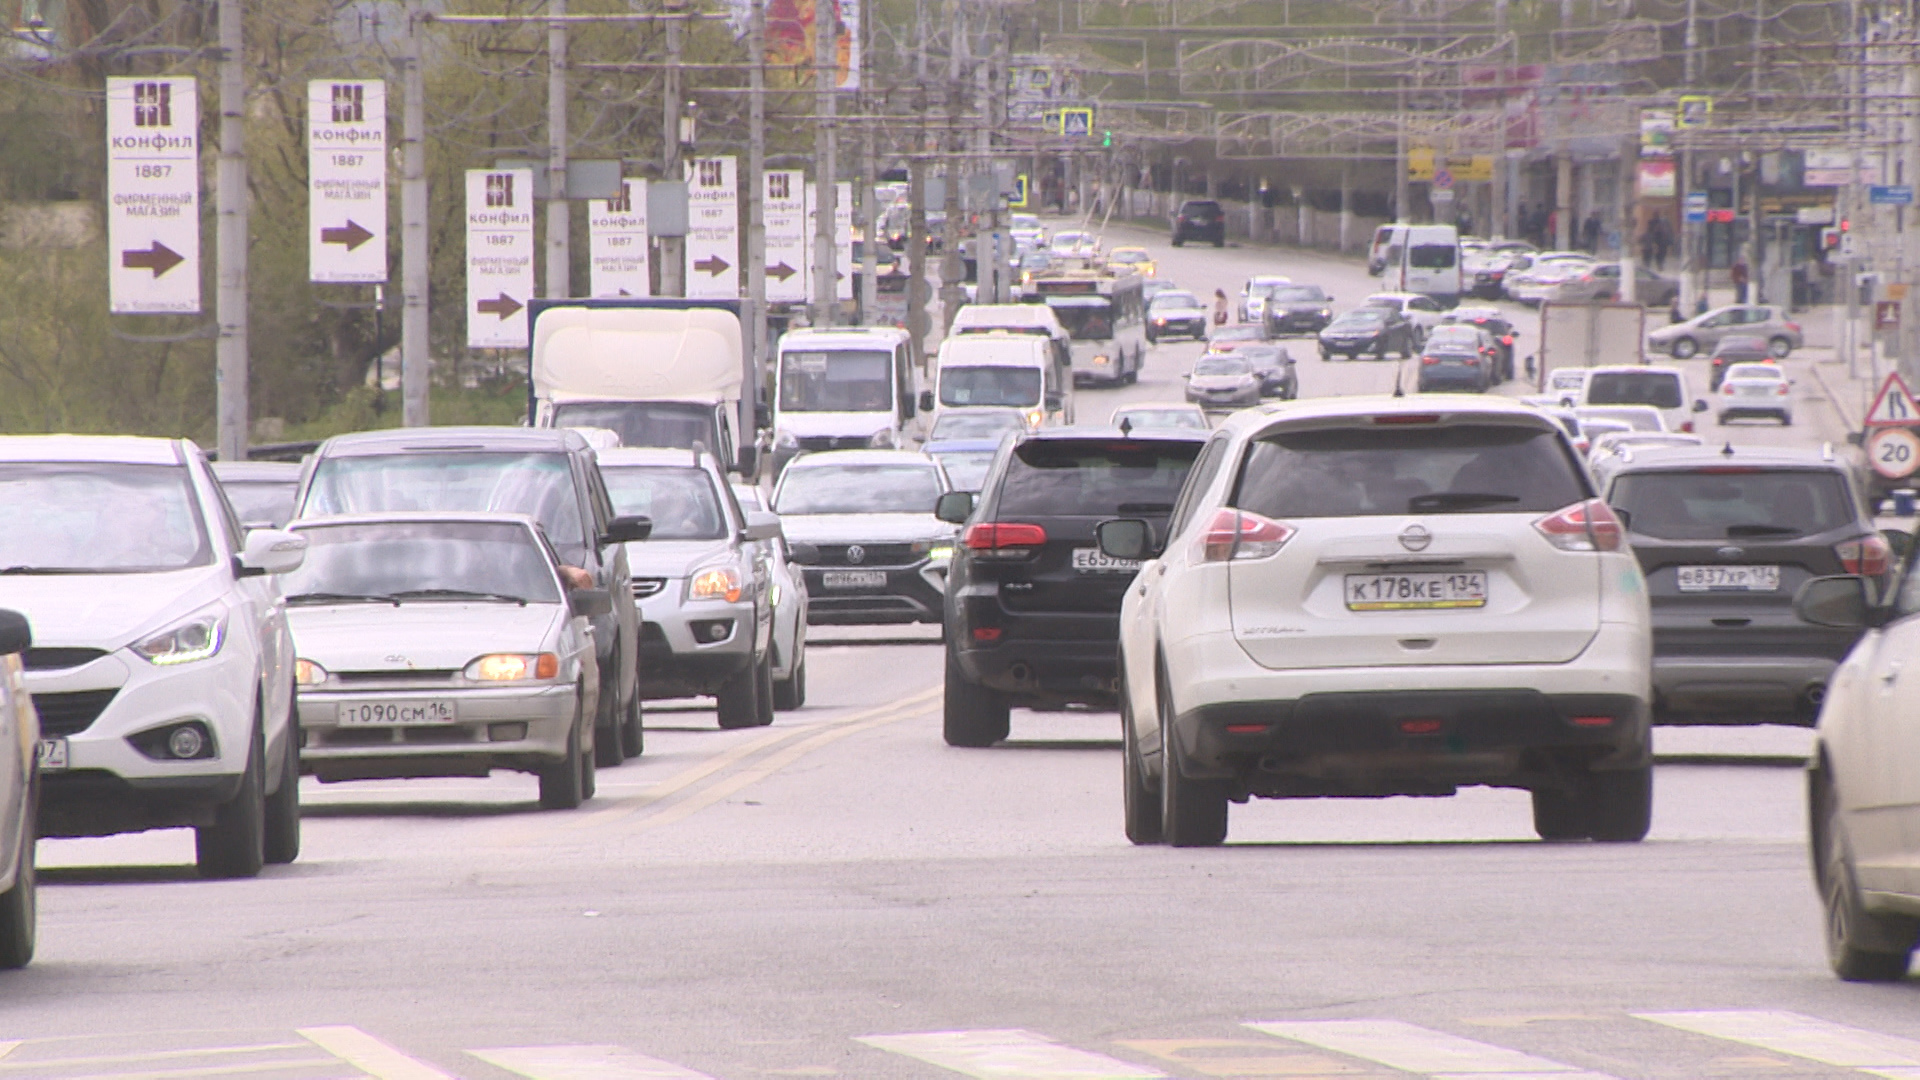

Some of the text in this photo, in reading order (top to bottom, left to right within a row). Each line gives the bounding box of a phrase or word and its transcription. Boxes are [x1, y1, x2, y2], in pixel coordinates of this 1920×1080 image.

[112, 131, 192, 151] КОНФИЛ
[313, 128, 381, 143] КОНФИЛ
[332, 155, 364, 166] 1887
[135, 165, 172, 177] 1887
[114, 192, 192, 205] ФИРМЕННЫЙ
[126, 206, 180, 216] МАГАЗИН
[470, 211, 530, 225] КОНФИЛ
[592, 216, 645, 229] КОНФИЛ
[486, 235, 514, 245] 1887
[608, 237, 632, 246] 1887
[1881, 443, 1910, 462] 20
